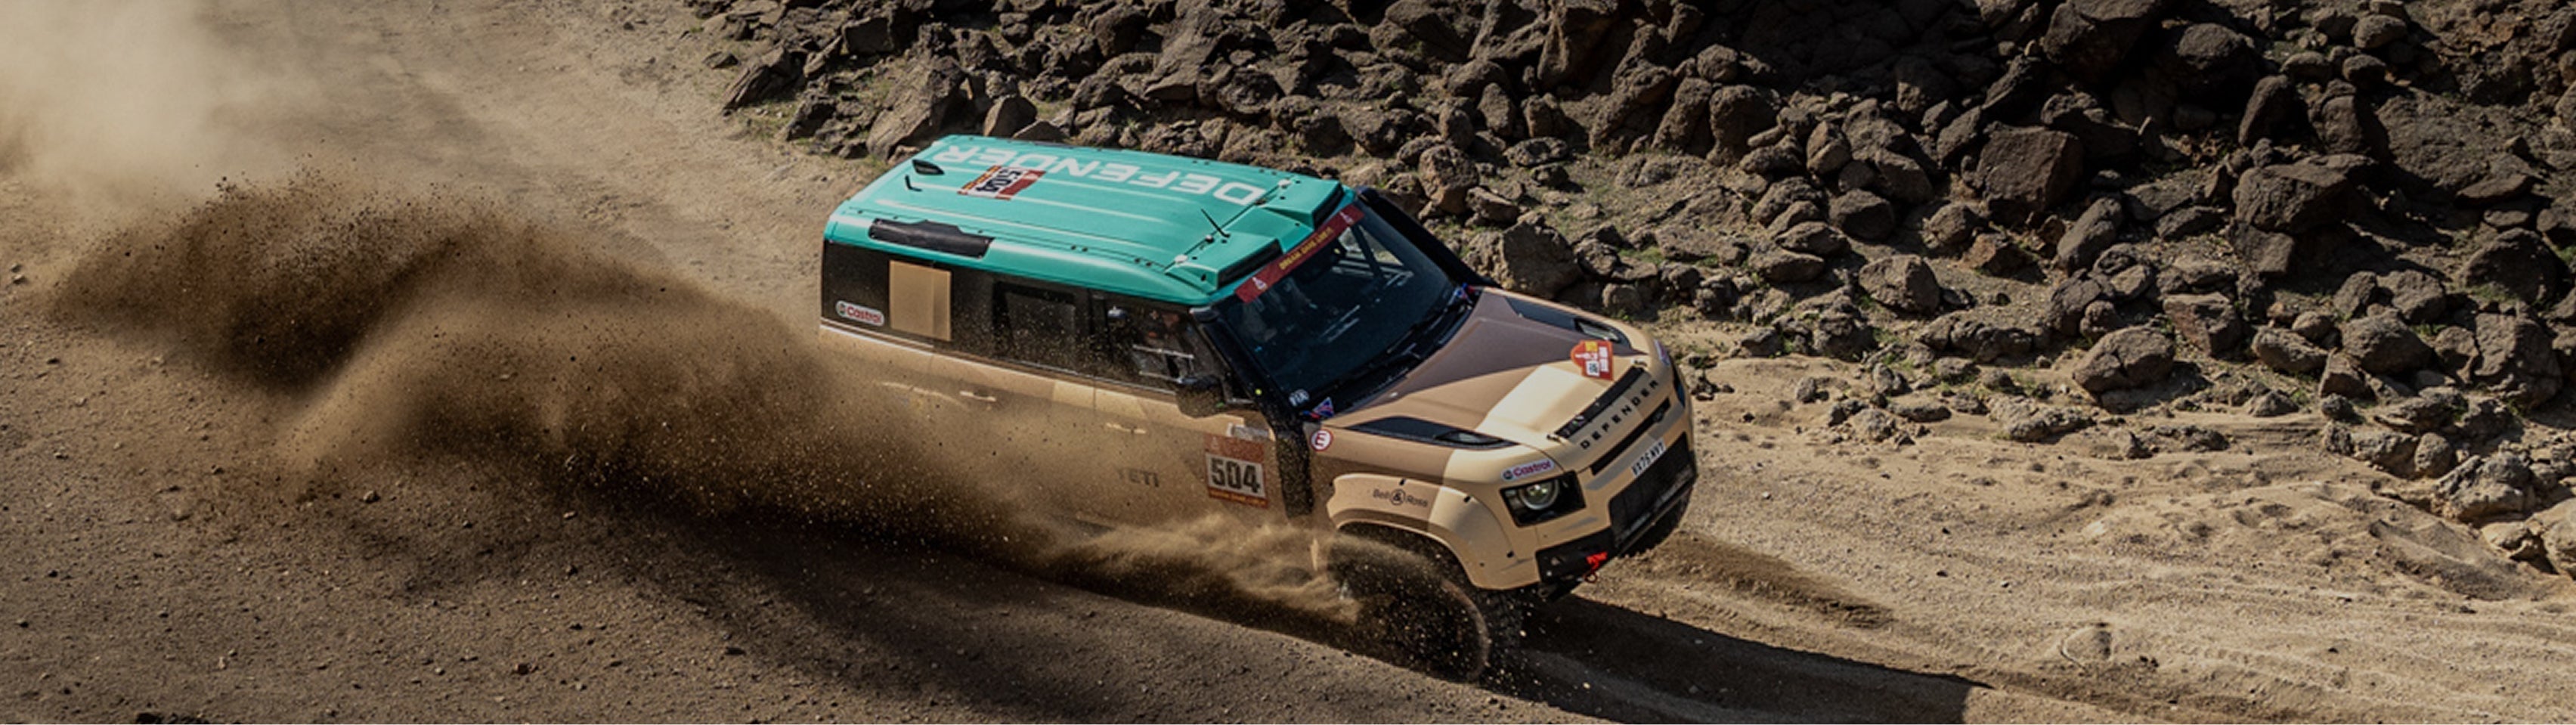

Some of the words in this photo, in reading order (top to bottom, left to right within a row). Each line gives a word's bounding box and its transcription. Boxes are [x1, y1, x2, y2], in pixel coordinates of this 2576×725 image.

[933, 145, 1266, 206] DEFENDER
[976, 169, 1022, 192] 504
[847, 305, 881, 324] Castrol
[1581, 380, 1658, 450] DEFENDER
[1315, 432, 1327, 448] E
[1211, 457, 1261, 494] 504
[1513, 460, 1551, 476] Castrol
